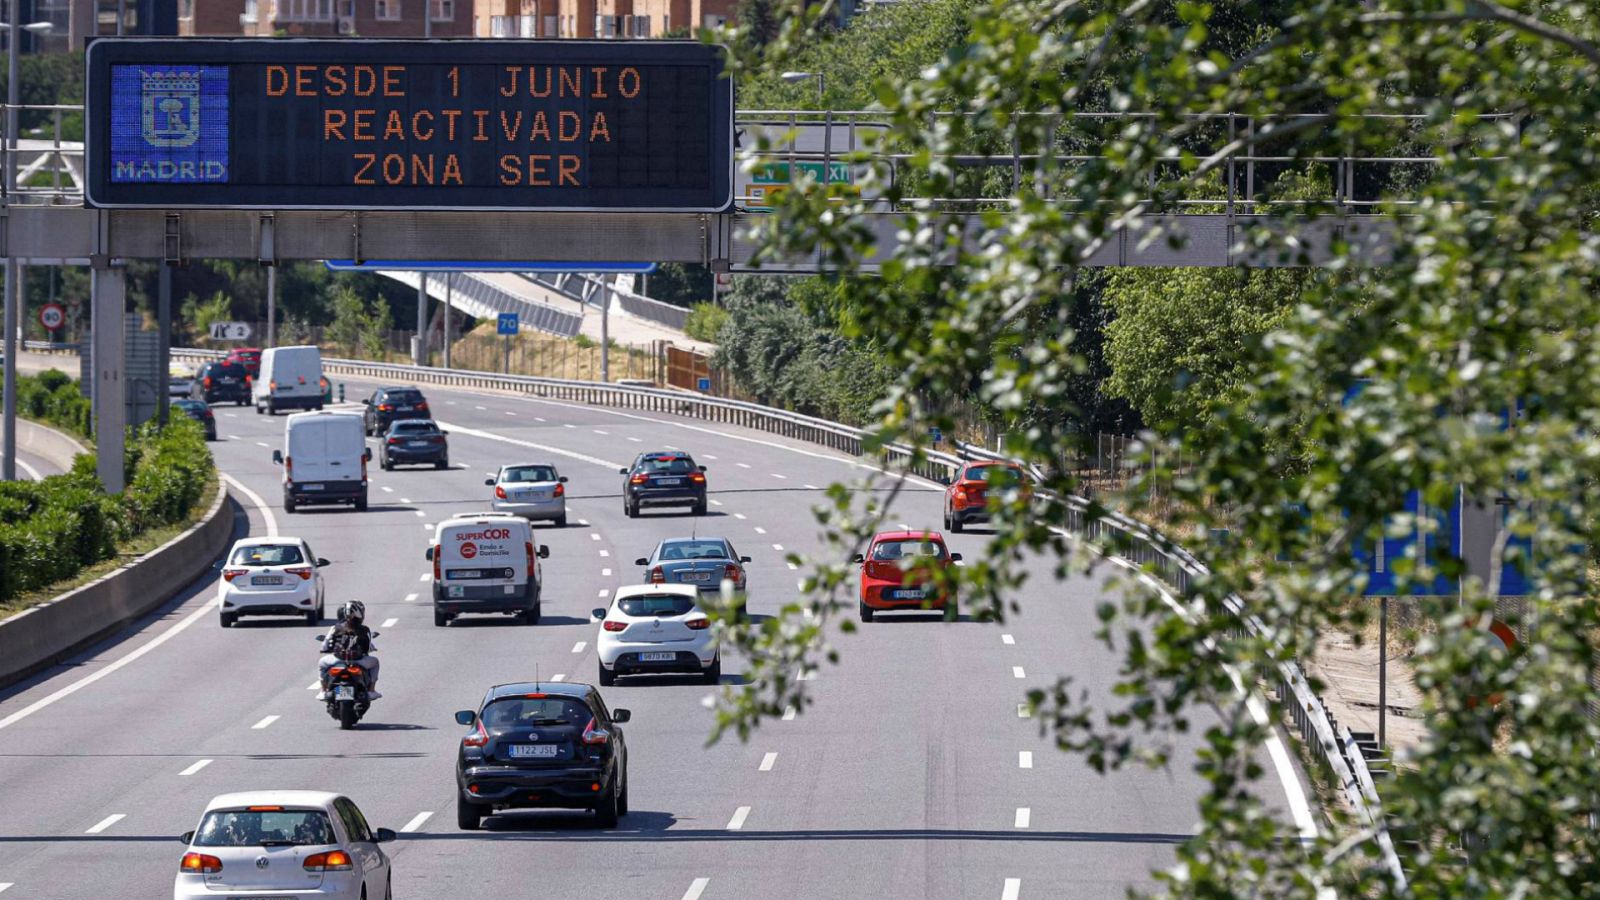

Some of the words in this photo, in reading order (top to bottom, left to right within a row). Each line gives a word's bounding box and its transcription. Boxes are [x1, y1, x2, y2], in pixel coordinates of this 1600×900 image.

[266, 65, 406, 97] DESDE
[447, 66, 459, 98] 1
[500, 66, 641, 98] JUNIO
[324, 109, 611, 142] REACTIVADA
[116, 160, 226, 179] MADRID
[353, 153, 464, 186] ZONA
[500, 154, 581, 186] SER
[236, 325, 245, 337] 2
[500, 318, 517, 330] 70
[515, 745, 537, 755] 1122
[538, 745, 555, 755] JSL
